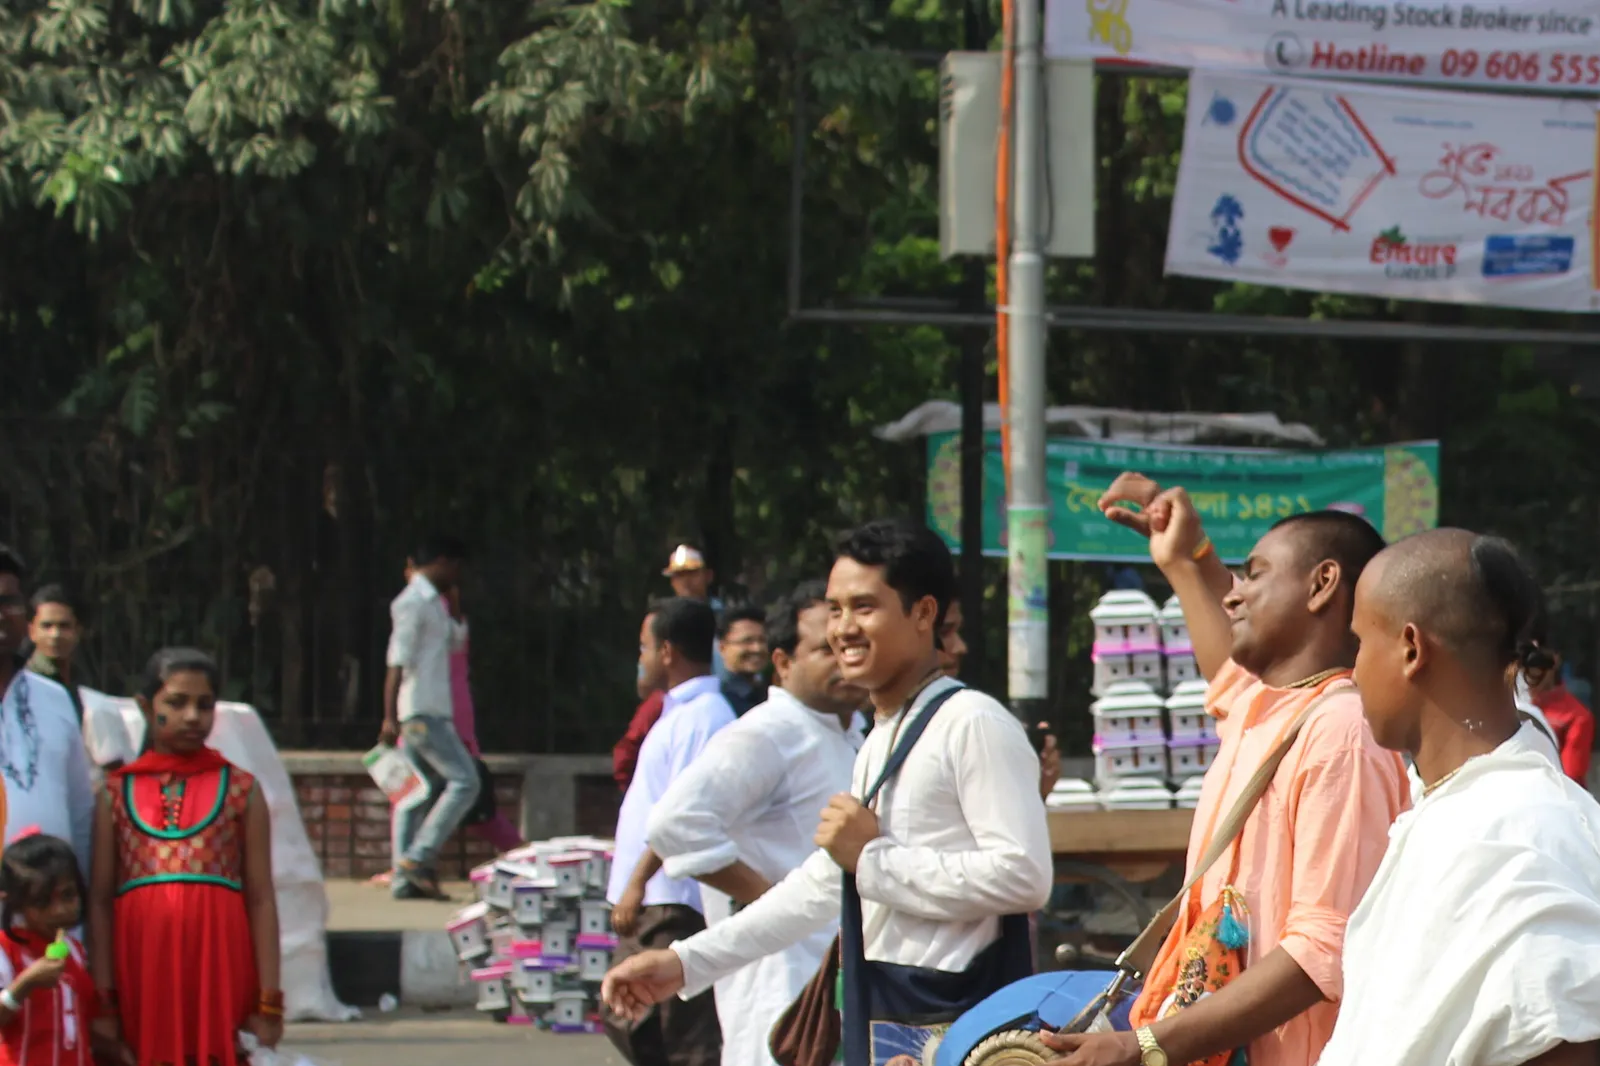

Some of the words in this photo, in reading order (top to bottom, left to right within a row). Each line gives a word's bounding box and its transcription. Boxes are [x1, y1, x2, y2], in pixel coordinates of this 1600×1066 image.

[1296, 0, 1385, 29] Leading
[1394, 3, 1453, 29] Stock
[1460, 7, 1532, 33] Broker
[1538, 11, 1591, 35] since
[1310, 41, 1426, 76] Hotline
[1441, 48, 1479, 78] 09
[1486, 51, 1540, 81] 606
